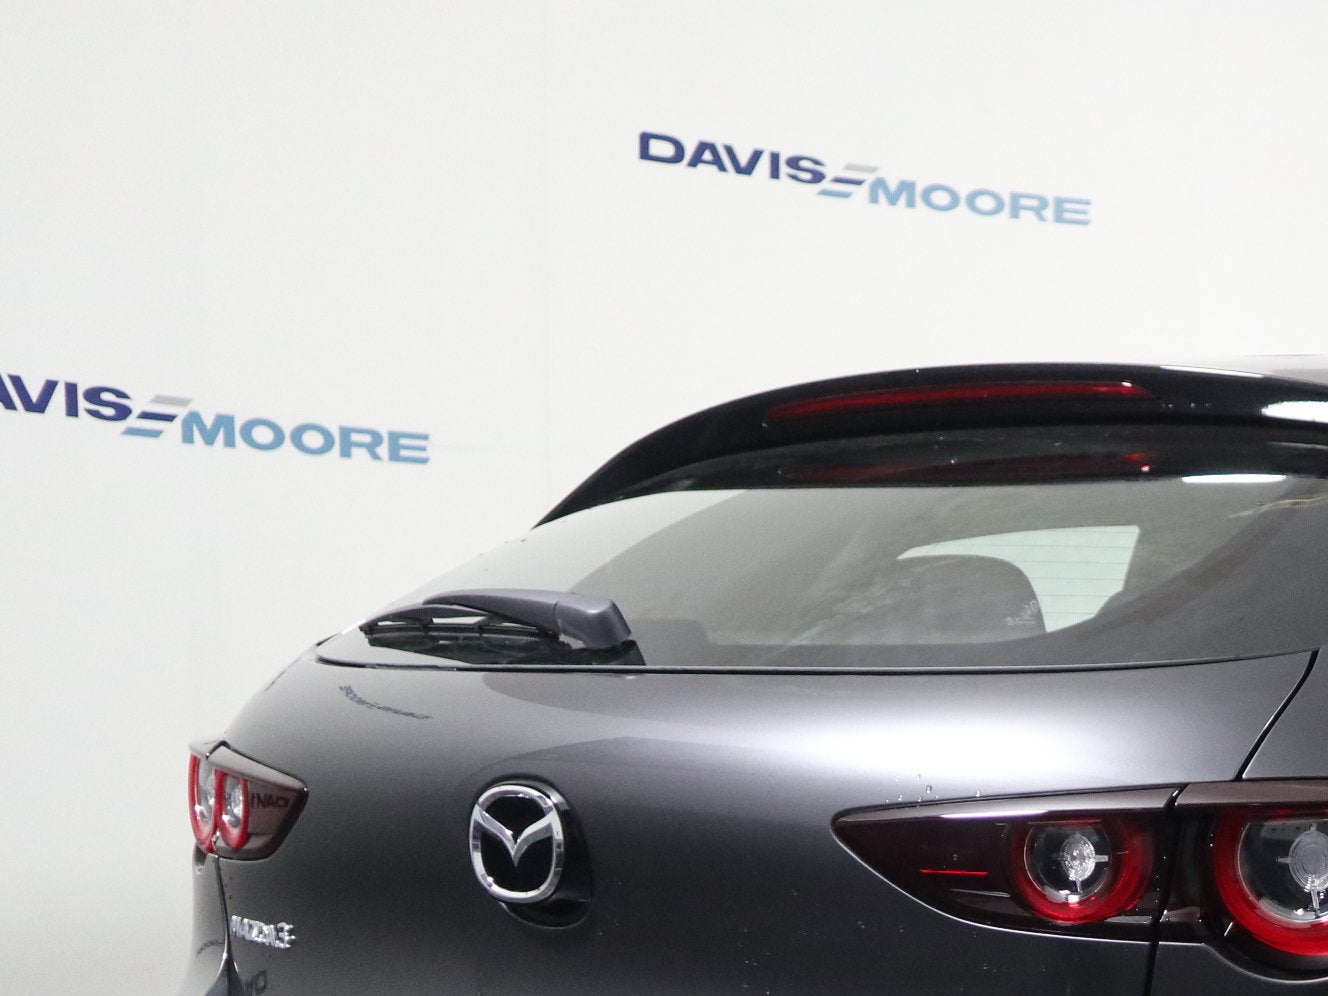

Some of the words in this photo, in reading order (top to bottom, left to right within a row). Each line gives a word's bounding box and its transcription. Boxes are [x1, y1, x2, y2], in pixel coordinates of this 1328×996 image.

[637, 129, 828, 186] DAVIS
[868, 176, 1092, 228] MOORE
[180, 409, 430, 466] MOORE
